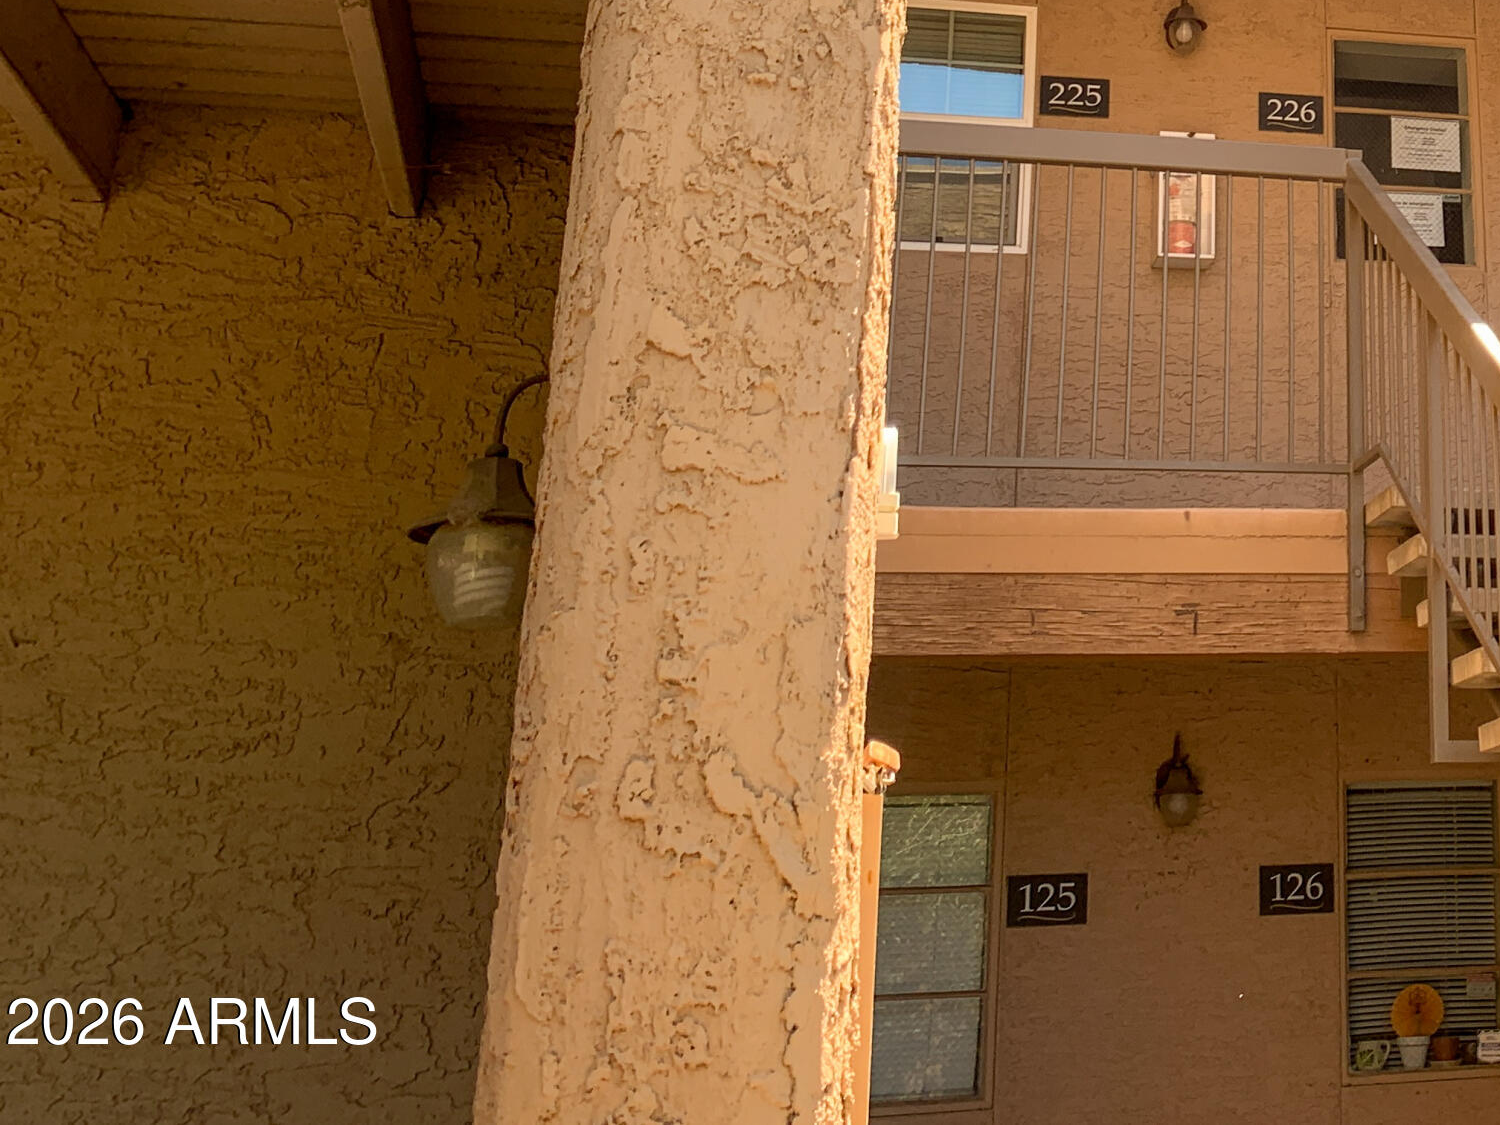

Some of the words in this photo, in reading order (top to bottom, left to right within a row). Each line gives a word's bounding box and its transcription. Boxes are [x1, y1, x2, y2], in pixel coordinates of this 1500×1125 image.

[1048, 82, 1102, 106] 225
[1266, 98, 1316, 123] 226
[1018, 882, 1076, 913] 125
[1269, 871, 1324, 902] 126
